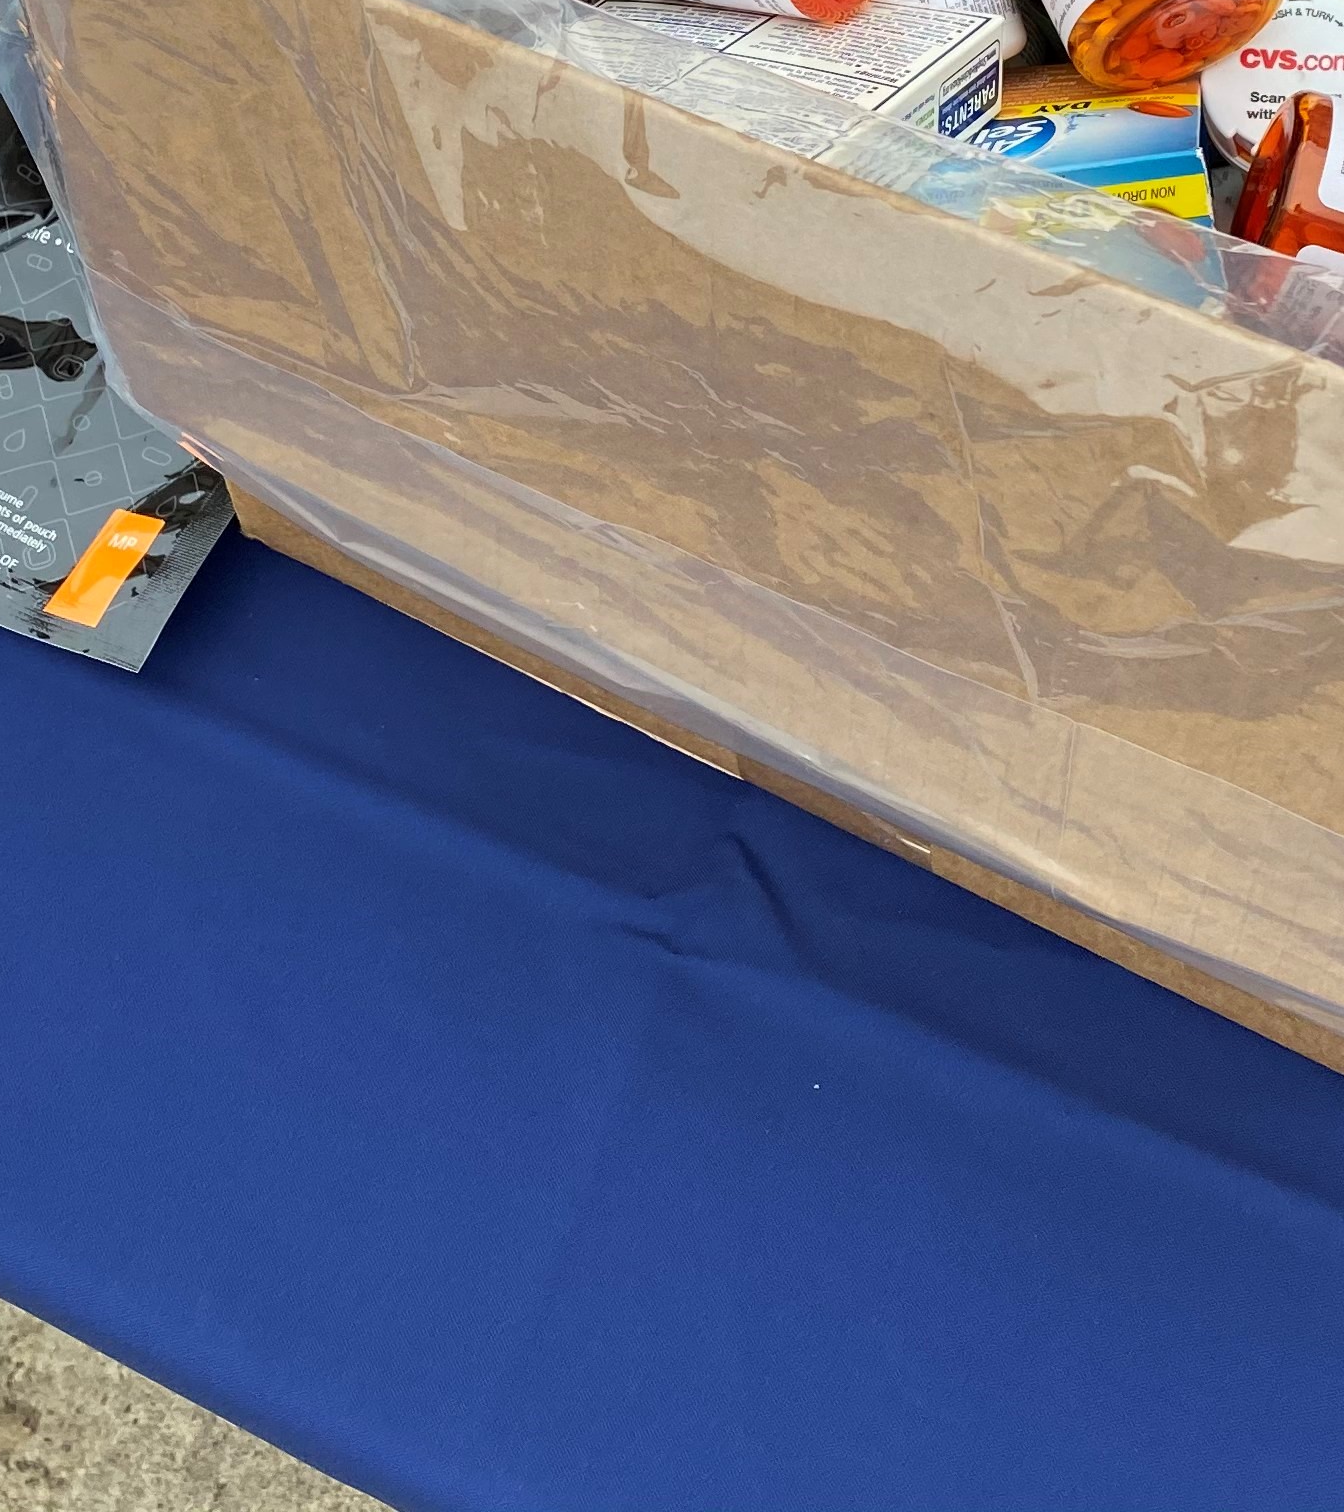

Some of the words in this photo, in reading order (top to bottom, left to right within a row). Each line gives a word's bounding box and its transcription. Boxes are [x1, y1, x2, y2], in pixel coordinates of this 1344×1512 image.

[1306, 8, 1334, 23] TURN
[1250, 91, 1286, 104] Scan
[1032, 99, 1092, 117] DAY
[1150, 185, 1176, 200] NON
[11, 513, 26, 524] of
[23, 520, 56, 541] pouch
[0, 554, 19, 568] OF
